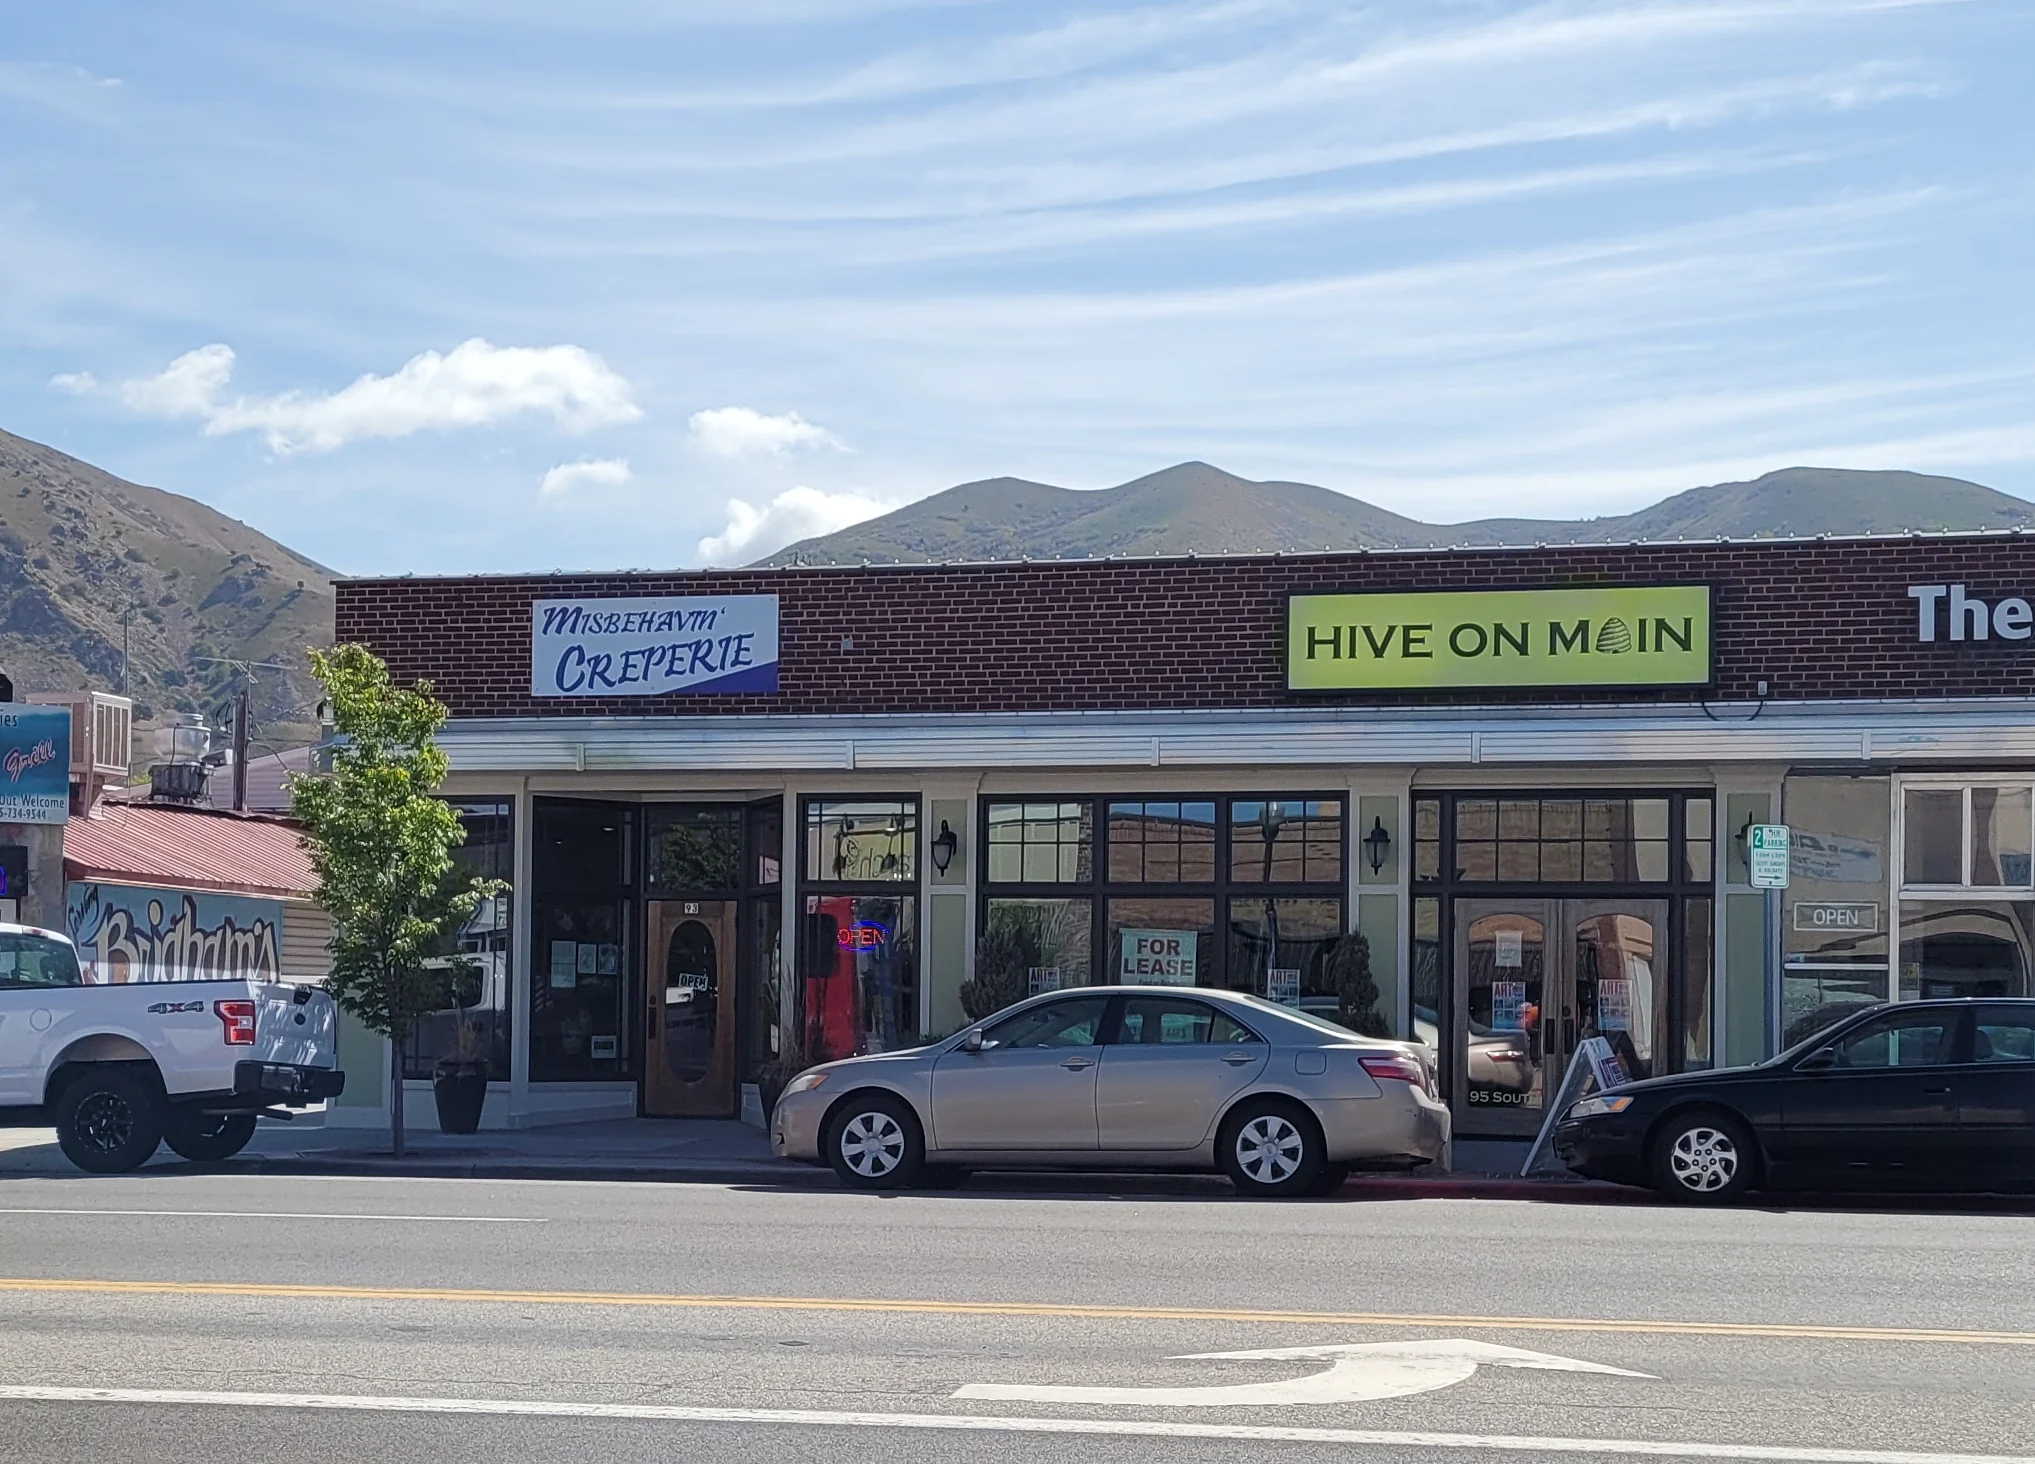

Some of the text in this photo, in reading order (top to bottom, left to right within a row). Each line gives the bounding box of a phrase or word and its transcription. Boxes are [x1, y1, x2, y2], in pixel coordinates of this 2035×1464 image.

[1908, 584, 2033, 641] The
[1306, 622, 1434, 660] HIVE
[1449, 621, 1530, 658] ON
[556, 632, 755, 692] CREPERIE
[21, 794, 65, 809] Welcome
[1754, 829, 1762, 846] 2
[685, 903, 698, 913] 93
[1813, 908, 1859, 926] OPEN
[838, 928, 885, 945] OPEN
[1137, 938, 1180, 956] FOR
[1123, 957, 1194, 976] LEASE
[681, 974, 707, 990] OPEN
[1470, 1090, 1489, 1103] 95
